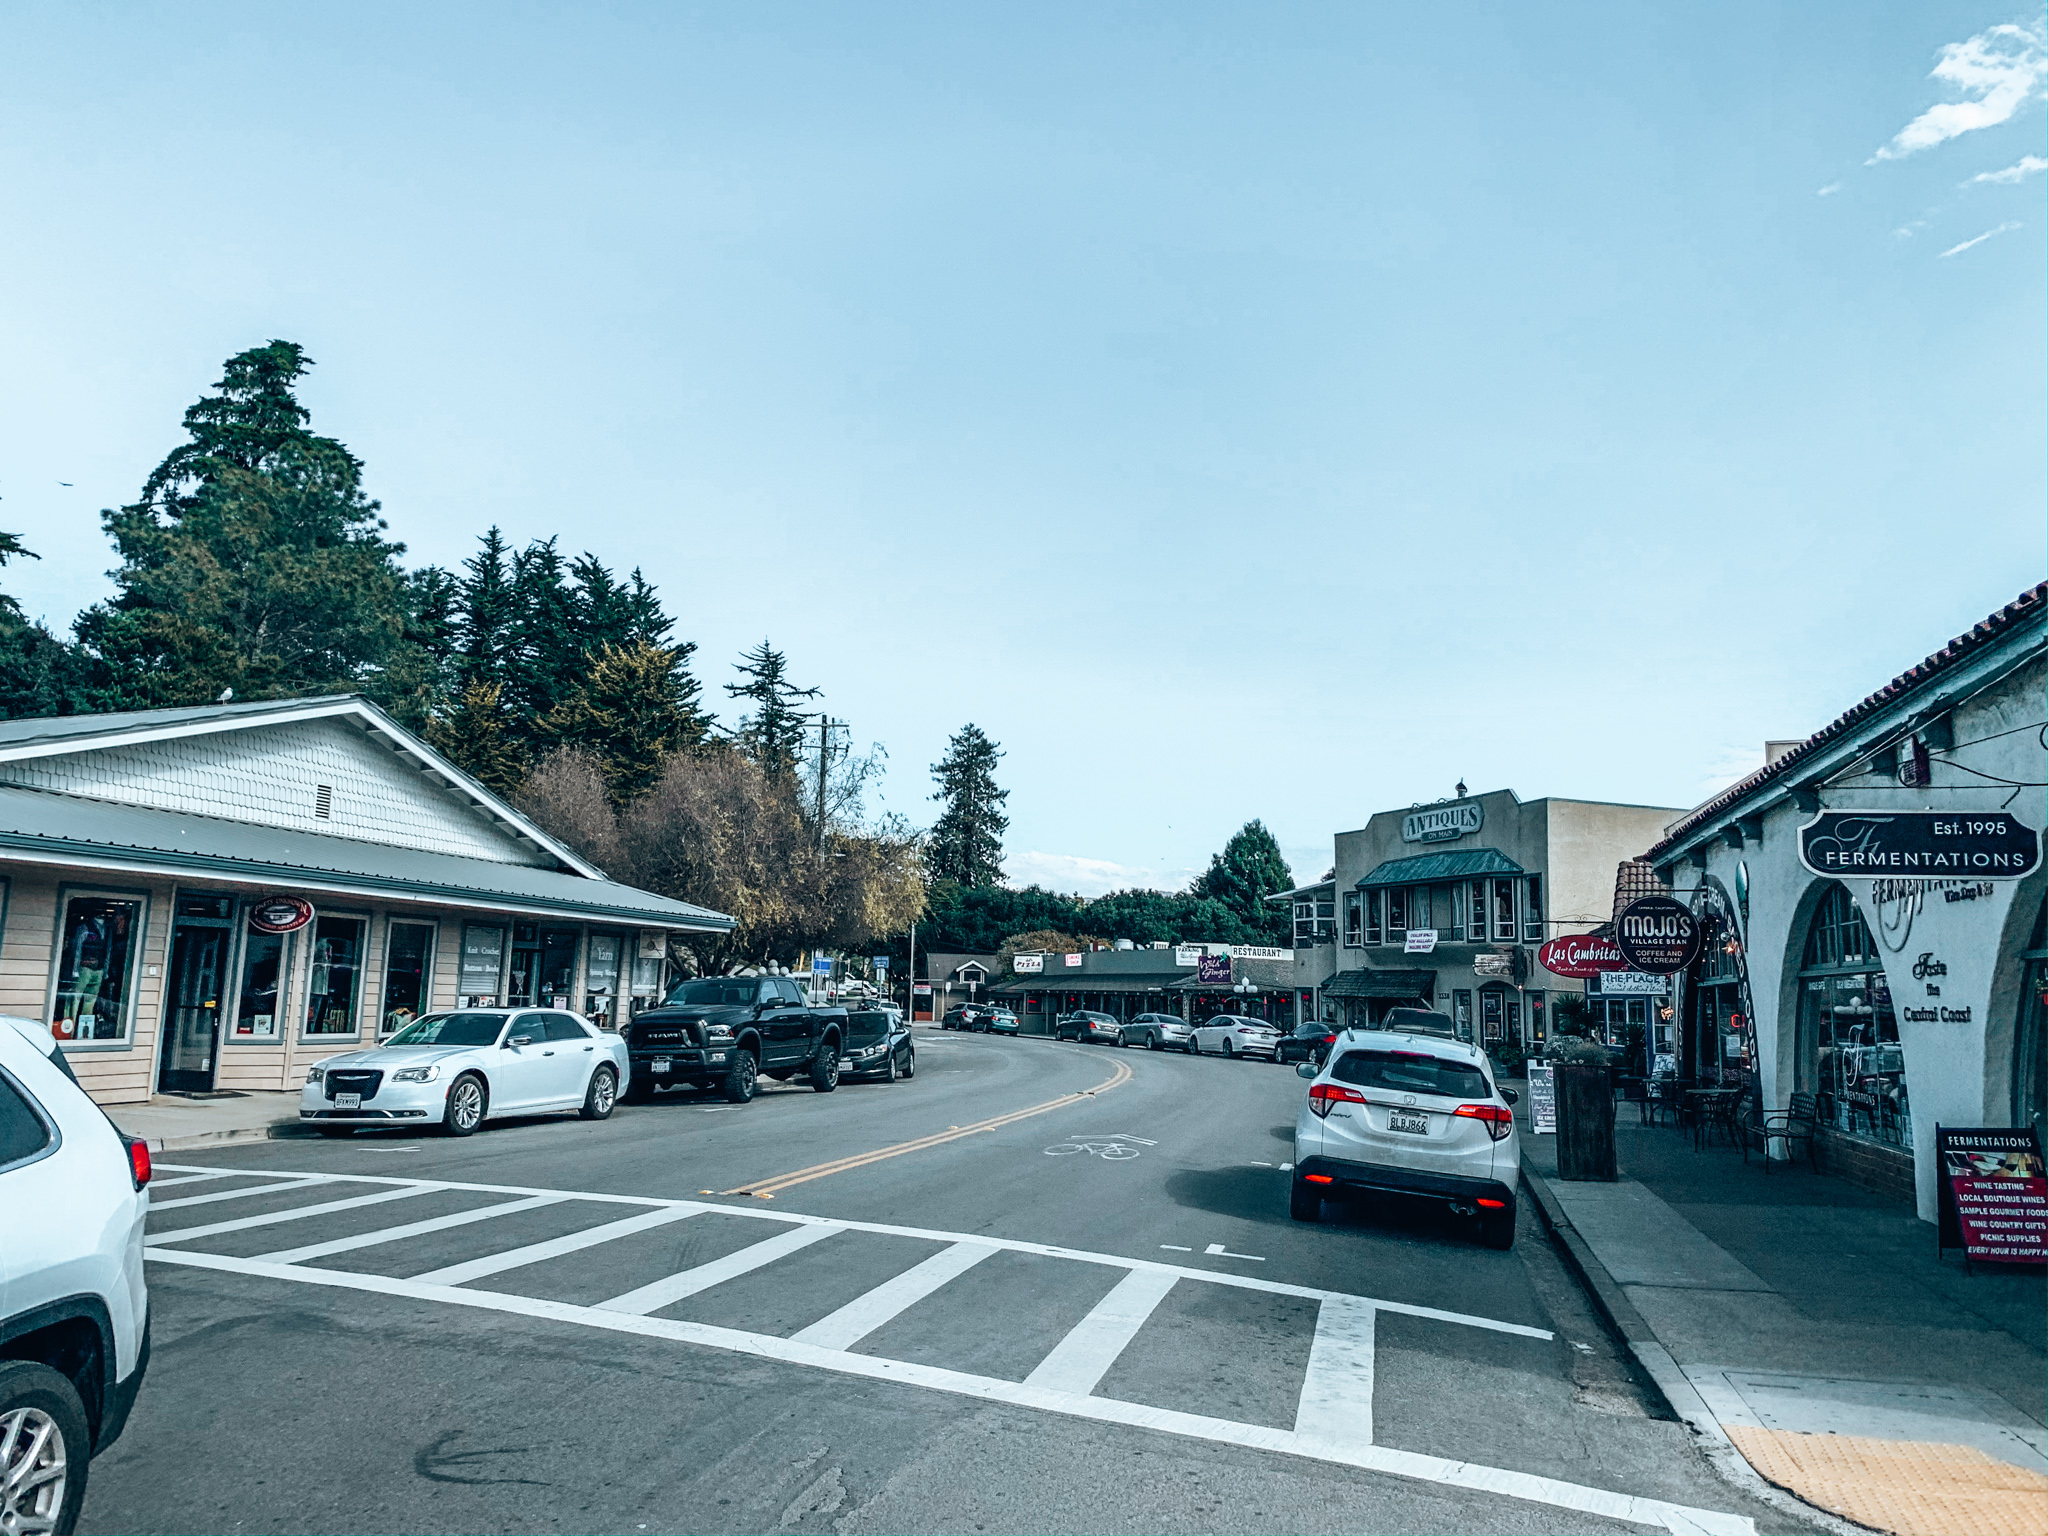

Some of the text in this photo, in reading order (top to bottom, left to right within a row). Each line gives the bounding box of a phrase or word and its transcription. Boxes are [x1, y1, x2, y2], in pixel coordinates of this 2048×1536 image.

[1407, 807, 1477, 836] ANTIQUES
[1934, 821, 2007, 835] Est. 1995
[1439, 830, 1453, 838] MAIN
[1826, 851, 2025, 867] FERMENTATIONS
[1624, 912, 1691, 937] MOJO'S
[597, 947, 613, 960] Yarn
[1233, 947, 1281, 958] RESTAURANT
[1547, 942, 1620, 966] Las Cambritas
[1202, 969, 1230, 979] Ginger
[1605, 973, 1660, 984] THE PLACE
[1927, 984, 1940, 996] the
[1904, 1006, 1972, 1023] Central Coast
[1391, 1116, 1427, 1132] 8LBJ866
[1948, 1135, 2033, 1148] FERMENTATIONS
[1973, 1182, 2025, 1191] WINE TASTING
[1959, 1194, 2046, 1204] LOCAL BOUTIQUE WINES
[1960, 1207, 1988, 1215] SAMPLE
[1990, 1208, 2024, 1216] GOURMET
[1969, 1220, 2046, 1230] WINE COUNTRY GIFTS
[1980, 1233, 2042, 1243] PICNIC SUPPLIES
[1968, 1246, 1989, 1254] EVERY
[1990, 1247, 2009, 1255] HOUR
[2011, 1247, 2018, 1255] IS
[2019, 1248, 2041, 1256] HAPPY
